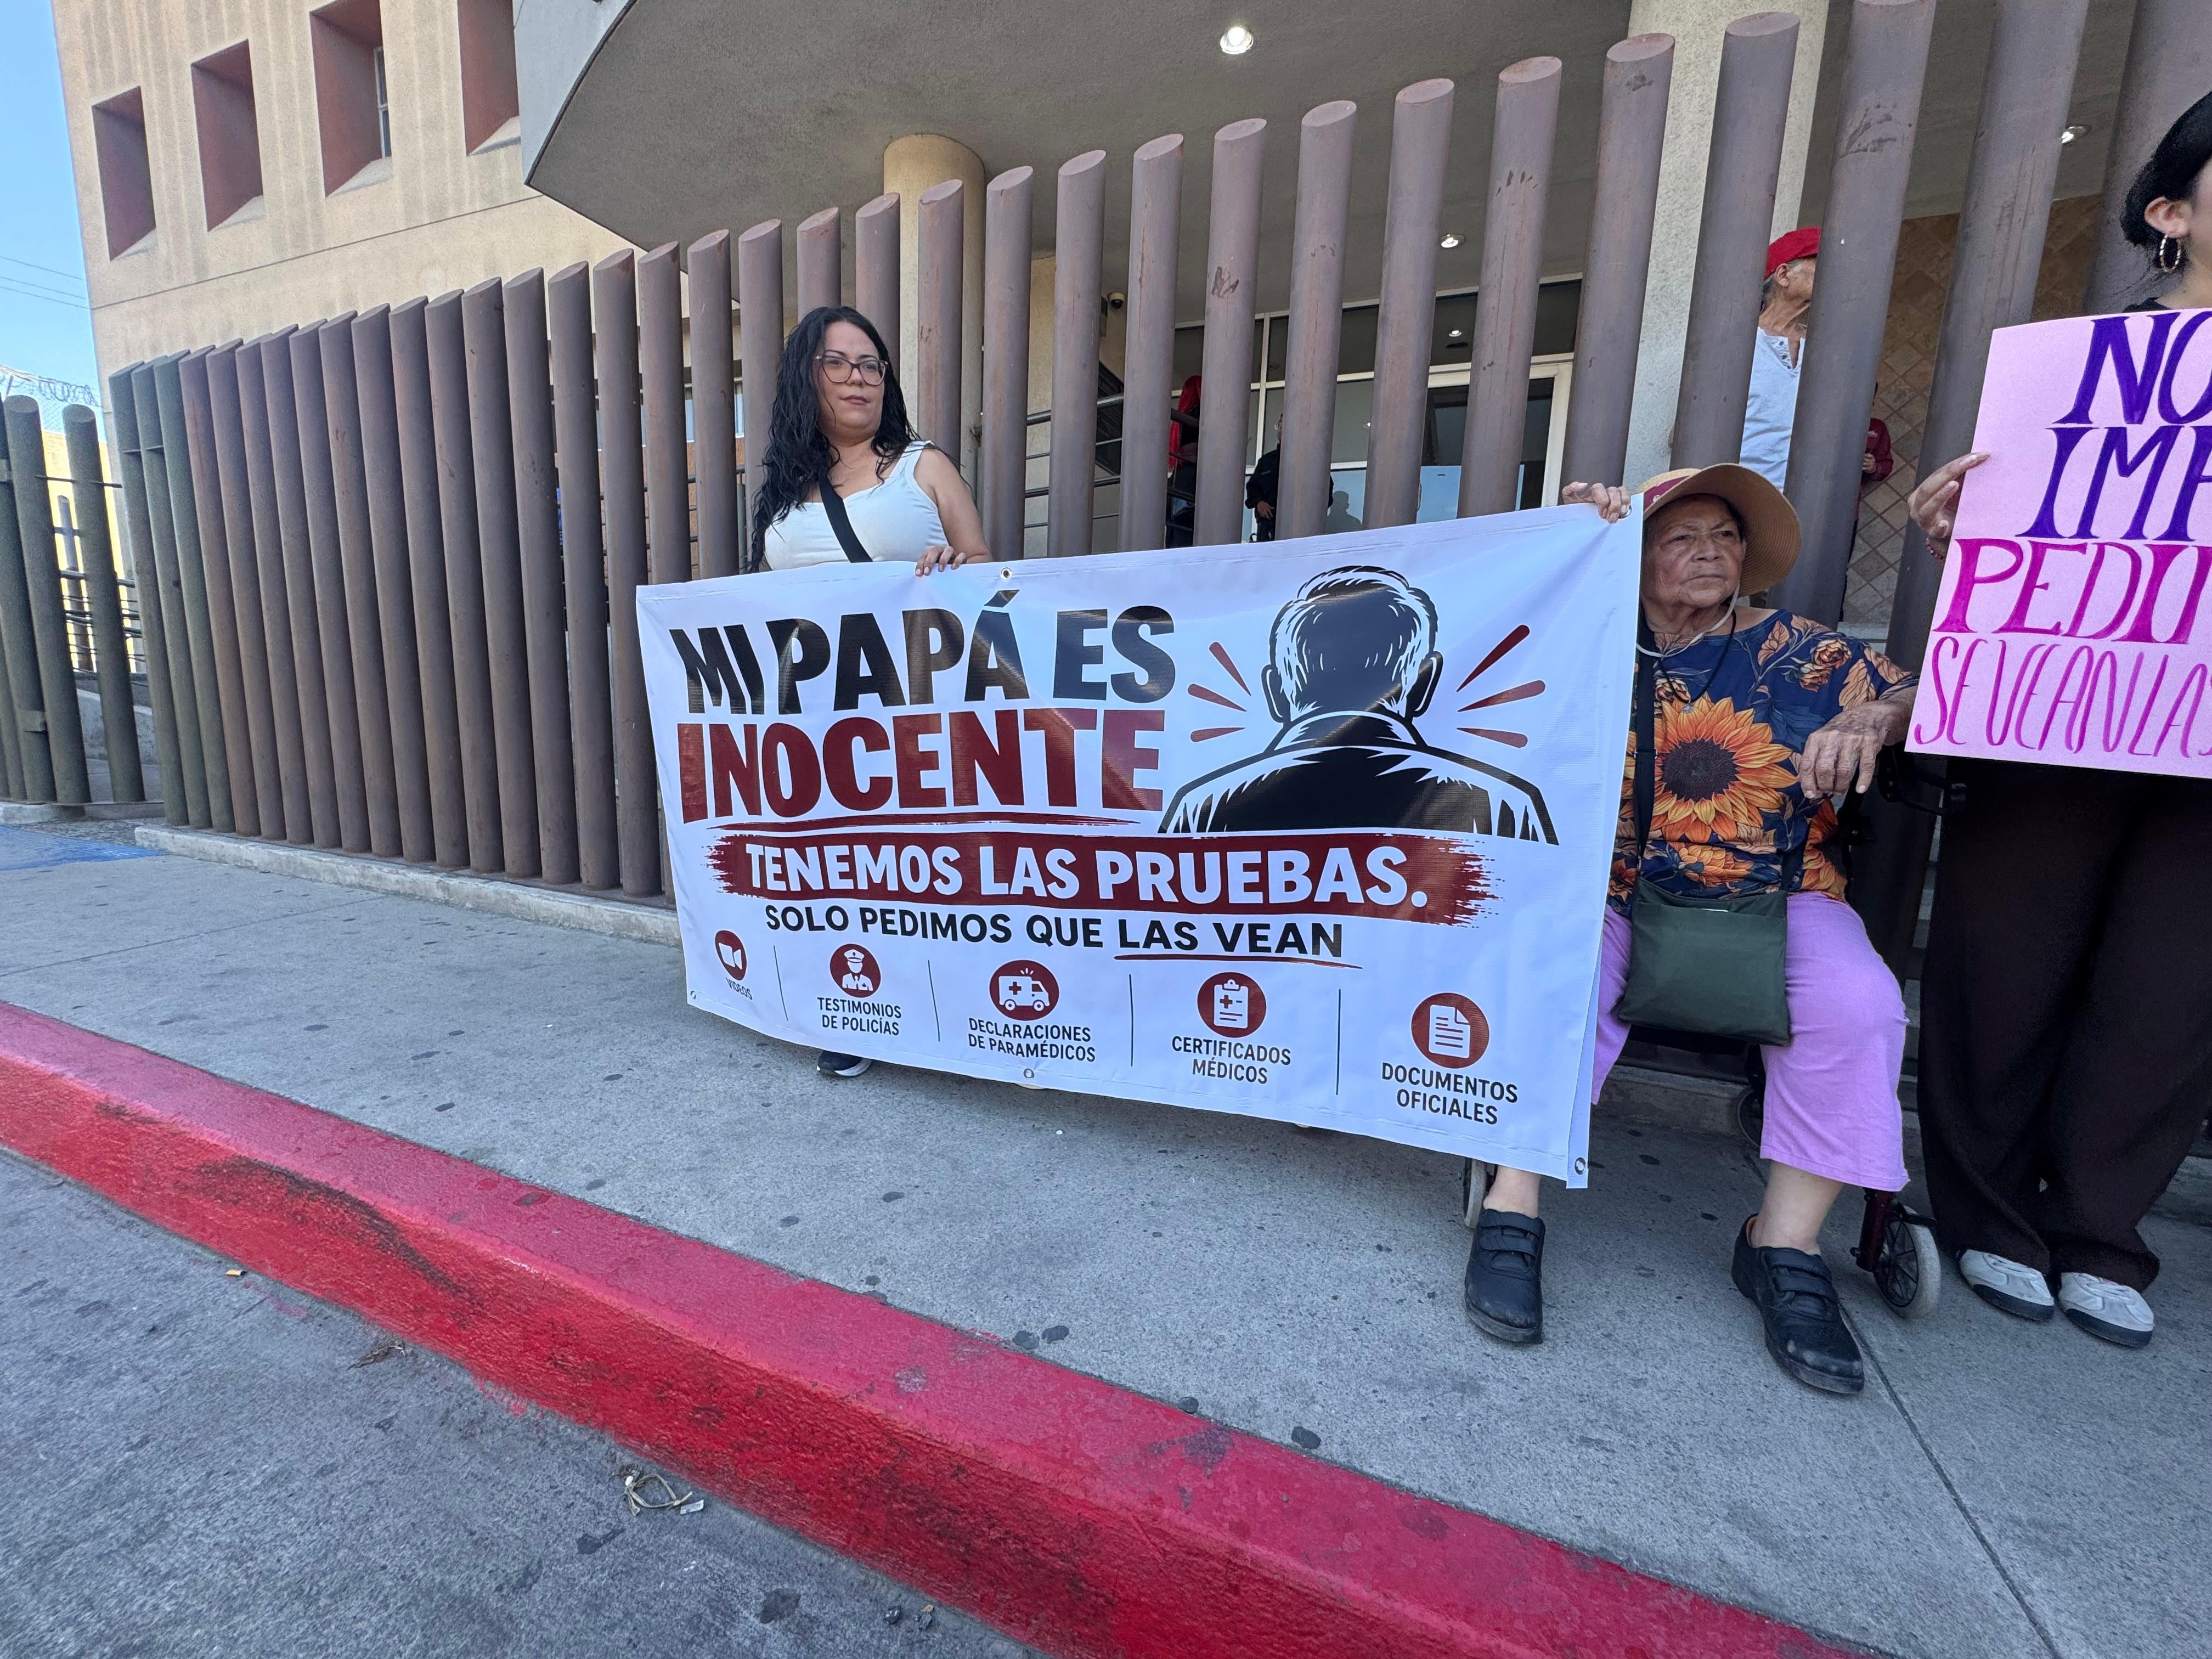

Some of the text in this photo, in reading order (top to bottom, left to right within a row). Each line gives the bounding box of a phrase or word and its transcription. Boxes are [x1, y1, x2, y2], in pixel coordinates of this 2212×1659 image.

[2052, 311, 2212, 425] NO
[668, 589, 1176, 715] MI PAPÁ ES
[2128, 654, 2212, 759] LA
[677, 708, 1165, 825] INOCENTE
[746, 843, 1427, 907] TENEMOS LAS PRUEBAS.
[765, 905, 1342, 958] SOLO PEDIMOS QUE LAS VEAN
[725, 977, 753, 1000] VIDEOS
[817, 997, 902, 1019] TESTIMONIOS
[822, 1014, 899, 1036] DE POLICÍAS
[968, 1018, 1091, 1042] DECLARACIONES
[968, 1033, 1096, 1063] DE PARAMÉDICOS
[1172, 1036, 1291, 1065] CERTIFICADOS
[1192, 1057, 1268, 1085] MÉDICOS
[1382, 1062, 1518, 1103] DOCUMENTOS
[1397, 1088, 1498, 1125] OFICIALES
